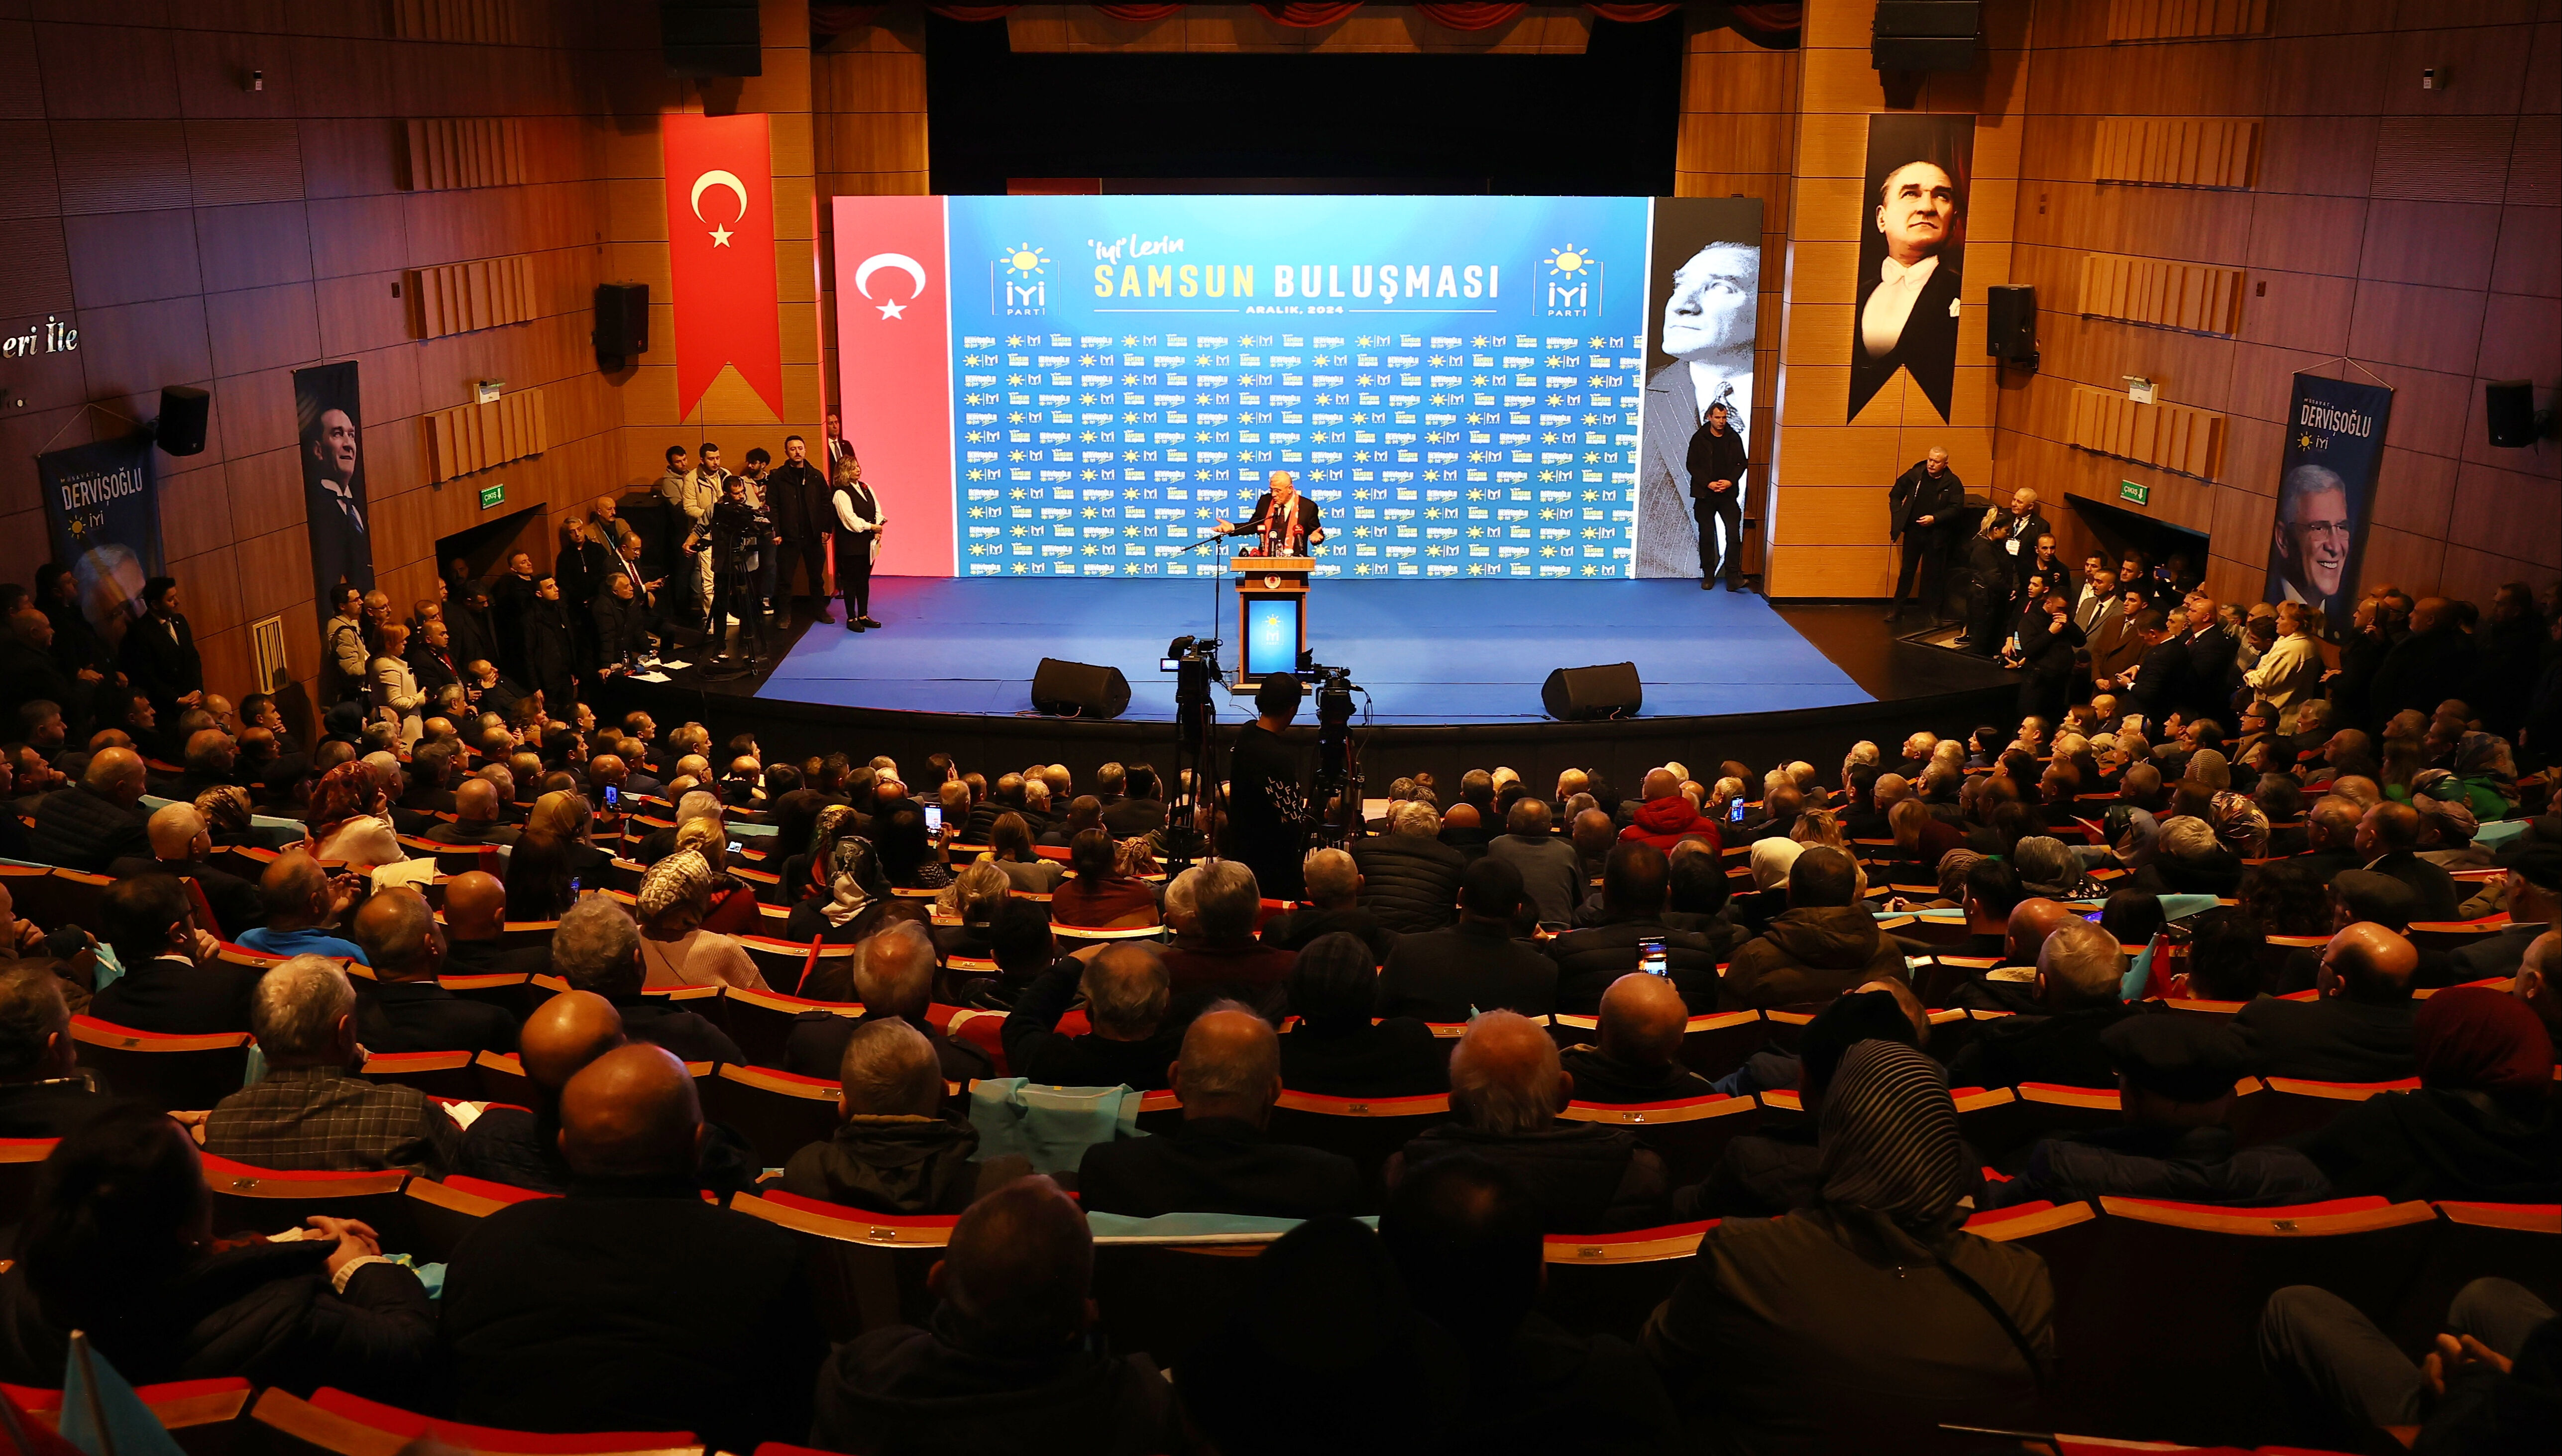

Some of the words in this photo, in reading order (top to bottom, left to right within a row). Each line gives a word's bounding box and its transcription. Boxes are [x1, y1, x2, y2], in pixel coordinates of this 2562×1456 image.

[1006, 281, 1045, 306] İYİ
[1095, 264, 1253, 298] SAMSUN
[1275, 265, 1498, 304] BULUŞMASI
[1549, 282, 1587, 308] İYİ
[1006, 308, 1045, 316] PARTİ
[1245, 306, 1304, 314] ARALIK,
[46, 315, 78, 353] İle
[2300, 405, 2372, 438] DERVİŞOĞLU
[2316, 435, 2329, 450] İYİ
[61, 467, 143, 510] DERVİŞOĞLU
[484, 491, 497, 502] ÇIKIŞ
[2123, 486, 2138, 496] ÇIKIŞ
[89, 510, 104, 527] İYİ
